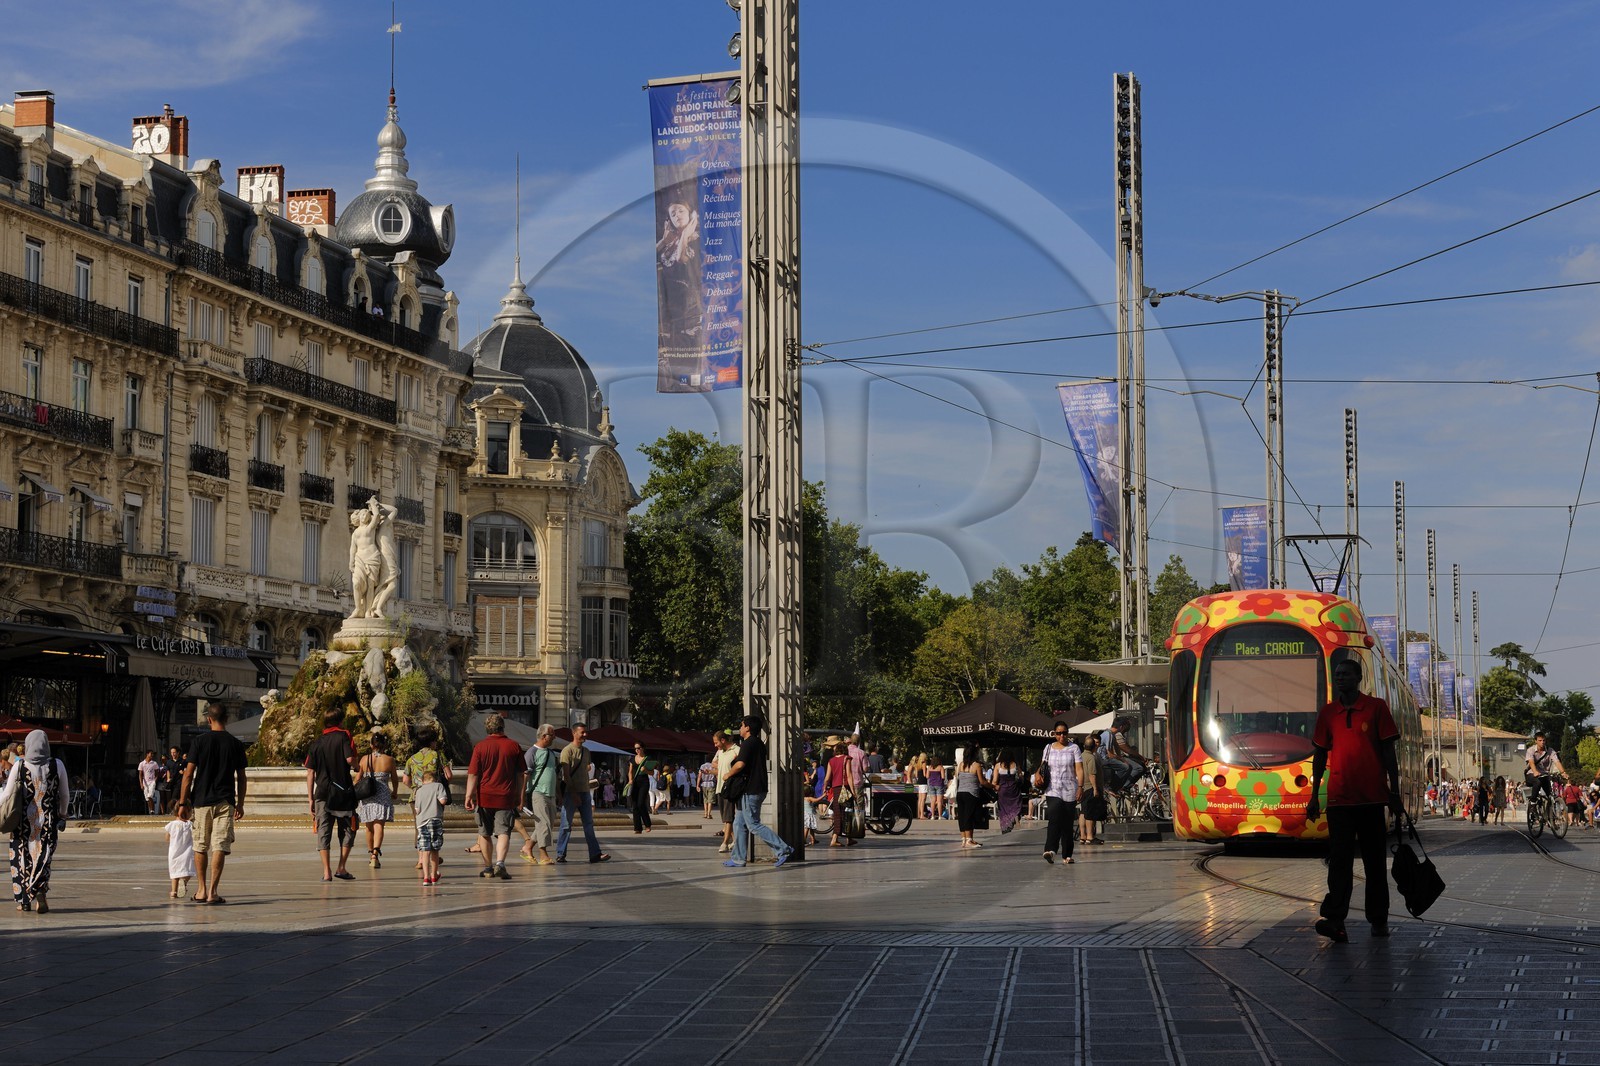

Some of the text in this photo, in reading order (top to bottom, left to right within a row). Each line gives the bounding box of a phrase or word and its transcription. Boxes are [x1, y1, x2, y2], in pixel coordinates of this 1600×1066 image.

[676, 92, 687, 102] Le
[689, 88, 721, 103] festival
[676, 98, 734, 113] RADIO FRANC
[674, 110, 738, 124] ET MONTPELLIER
[705, 132, 737, 141] JUILLET
[702, 160, 730, 170] Opéras
[703, 192, 735, 203] Récitals
[703, 210, 741, 221] Musiques
[704, 218, 742, 229] du monde
[705, 237, 723, 246] Jazz
[706, 253, 733, 263] Techno
[706, 271, 734, 281] Reggae
[706, 287, 733, 297] Débats
[706, 305, 728, 314] Films
[151, 635, 177, 656] Café
[179, 639, 201, 656] 1893
[1235, 642, 1304, 655] Place CARNOT
[922, 725, 974, 735] BRASSERIE
[978, 722, 995, 731] LES
[998, 722, 1026, 735] TROIS
[1207, 801, 1248, 810] Montpellier
